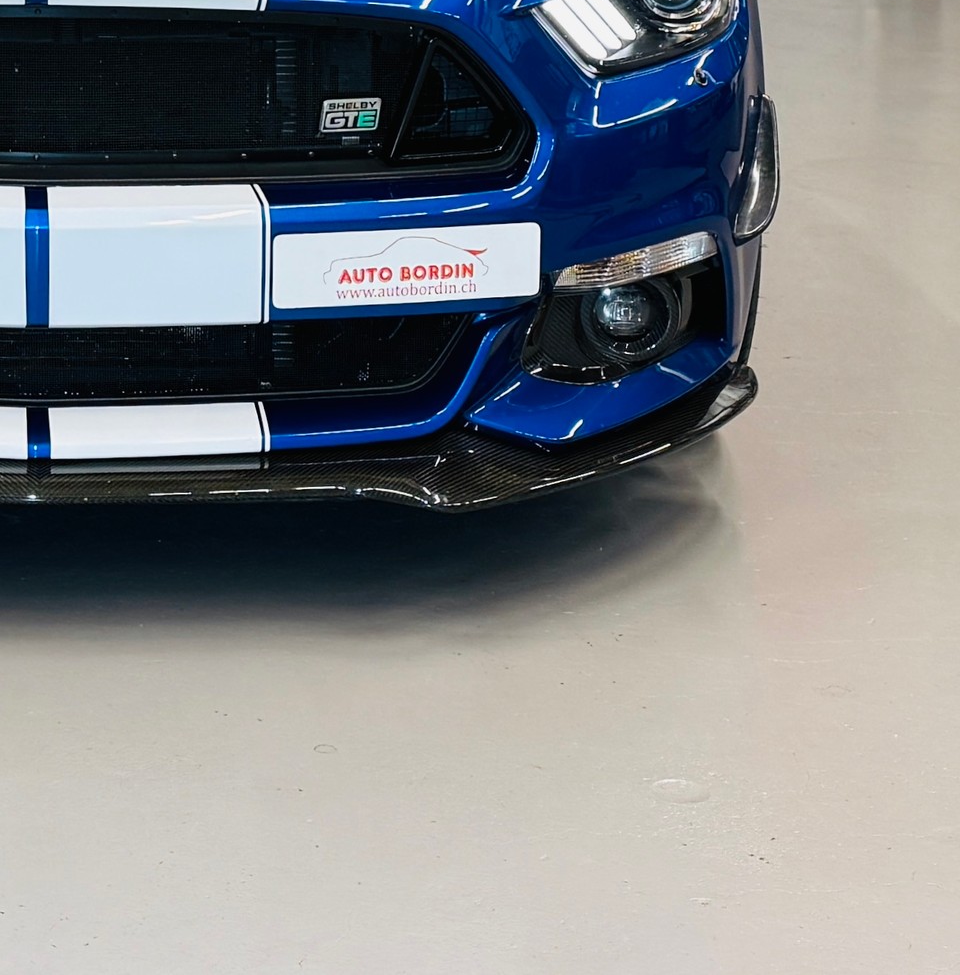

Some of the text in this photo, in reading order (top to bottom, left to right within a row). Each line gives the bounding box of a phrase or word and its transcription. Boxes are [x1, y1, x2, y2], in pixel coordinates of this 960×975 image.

[328, 101, 377, 110] SHELBY
[324, 110, 376, 129] GTE
[338, 263, 474, 285] AUTO BORDIN
[336, 281, 477, 300] www.autobordin.ch
